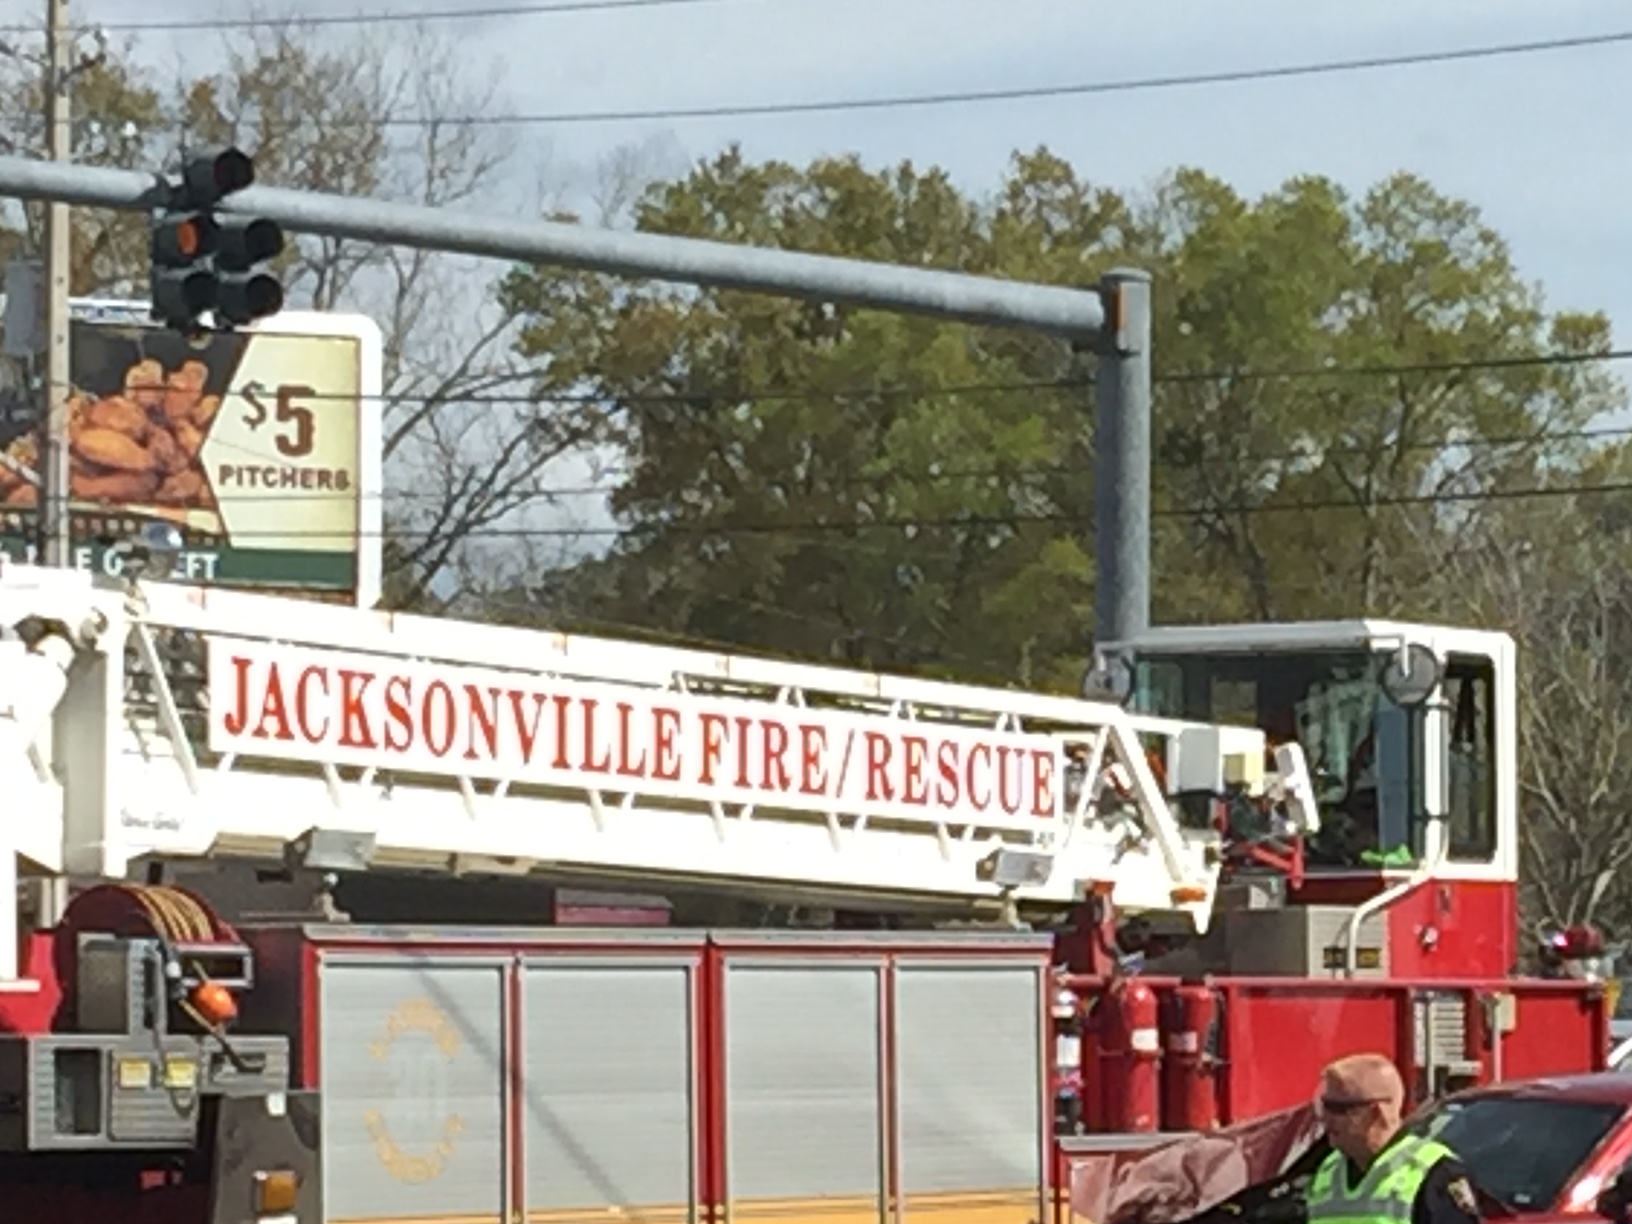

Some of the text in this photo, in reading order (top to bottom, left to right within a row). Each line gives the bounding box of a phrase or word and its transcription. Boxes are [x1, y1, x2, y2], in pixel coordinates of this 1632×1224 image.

[241, 379, 316, 458] $5
[218, 464, 351, 491] PITCHERS
[223, 656, 1056, 819] JACKSONVILLE FIRE/RESCUE
